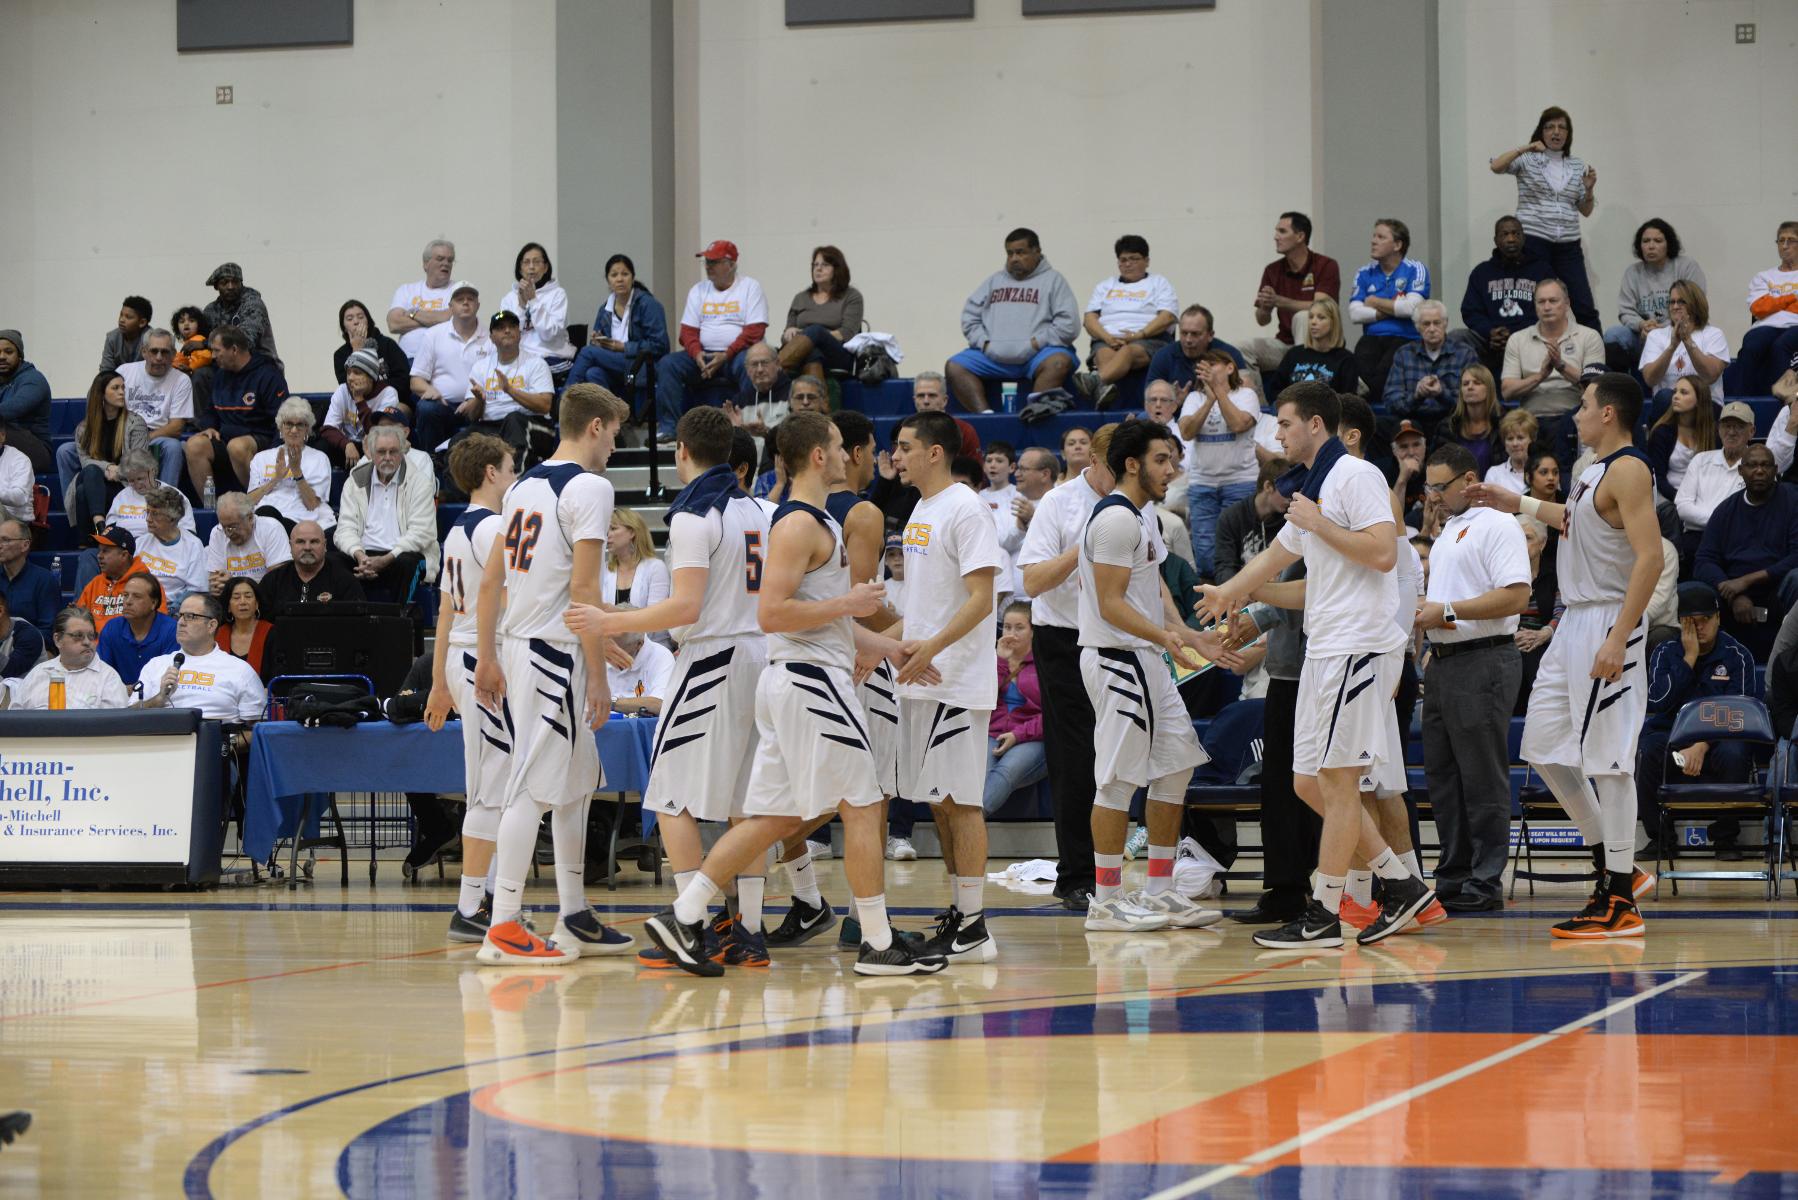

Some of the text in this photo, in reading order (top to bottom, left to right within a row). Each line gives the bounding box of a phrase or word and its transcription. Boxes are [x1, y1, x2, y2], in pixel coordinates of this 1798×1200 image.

[990, 287, 1039, 304] GONZAGA
[1492, 289, 1533, 301] BULLDOGS
[703, 301, 740, 315] COS
[504, 508, 543, 573] 42
[226, 551, 265, 571] COS
[744, 530, 763, 594] 5
[447, 557, 465, 614] 11
[178, 670, 215, 686] OS
[1700, 702, 1744, 731] COS
[0, 779, 109, 806] hell, Inc.
[4, 824, 14, 836] &
[20, 824, 84, 836] Insurance
[152, 824, 178, 836] Inc.
